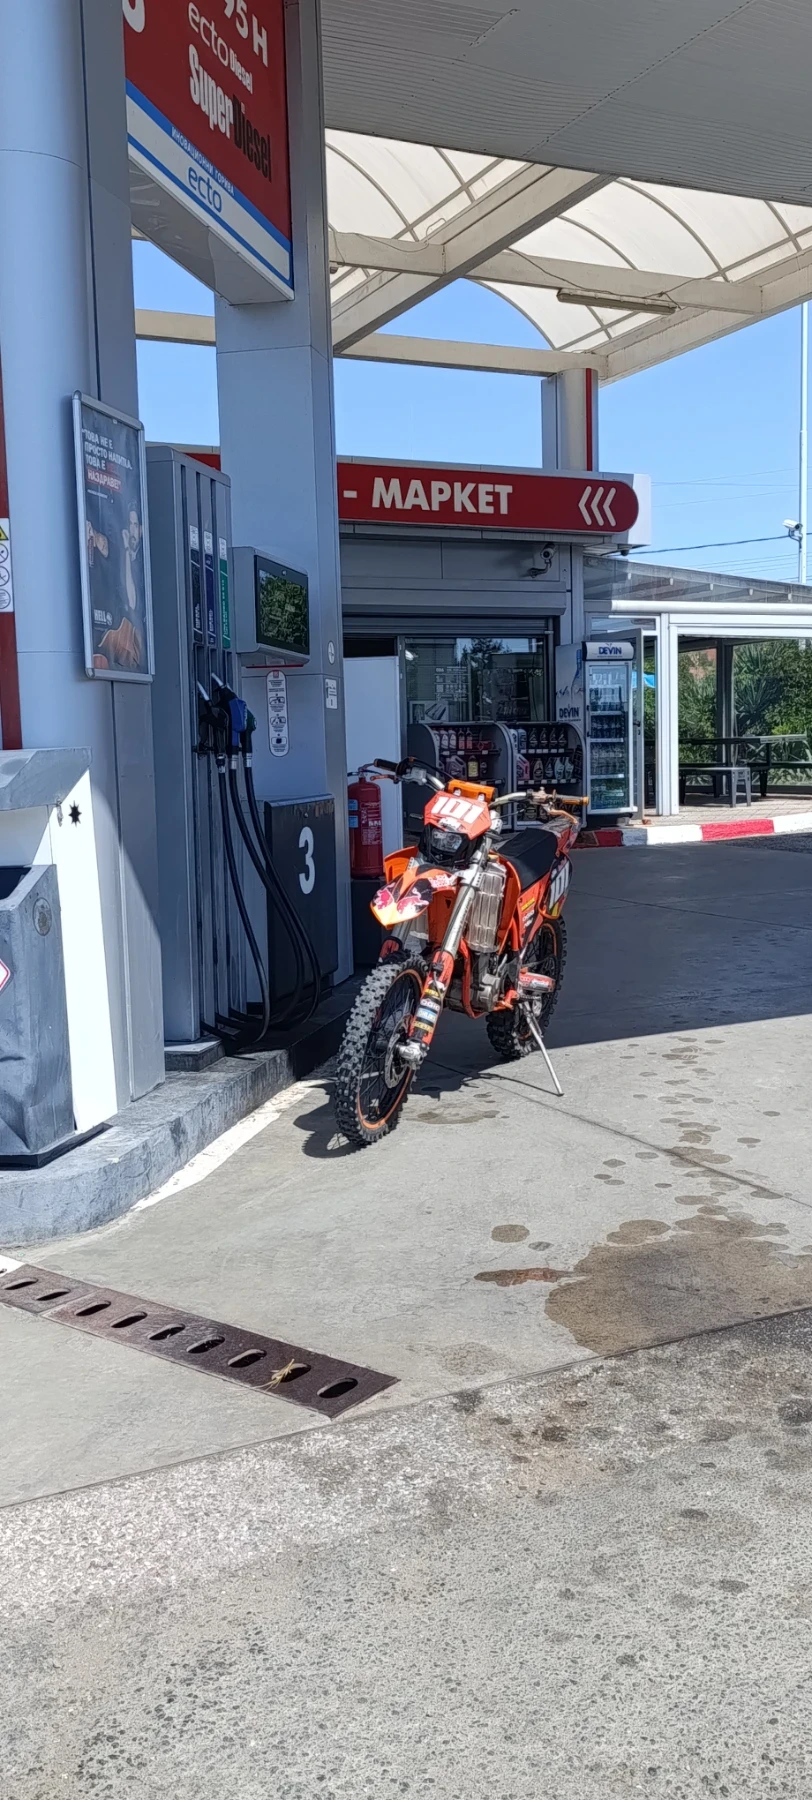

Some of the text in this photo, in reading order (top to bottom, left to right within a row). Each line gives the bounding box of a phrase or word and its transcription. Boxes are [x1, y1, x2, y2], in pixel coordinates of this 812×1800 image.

[187, 1, 229, 67] ecto
[171, 126, 235, 197] ИНОВАЦИОННИ ГОРИВА
[187, 166, 223, 213] ecto
[84, 441, 108, 458] ПРОСТО
[100, 435, 109, 448] НЕ
[108, 439, 114, 450] Е
[85, 454, 106, 470] ТОВА Е
[372, 476, 514, 516] МАРКЕТ
[93, 608, 107, 623] HELL
[598, 646, 622, 655] DEVIN
[558, 706, 580, 719] DEVIN
[430, 796, 485, 824] 101
[298, 825, 316, 895] 3
[548, 860, 570, 910] 101
